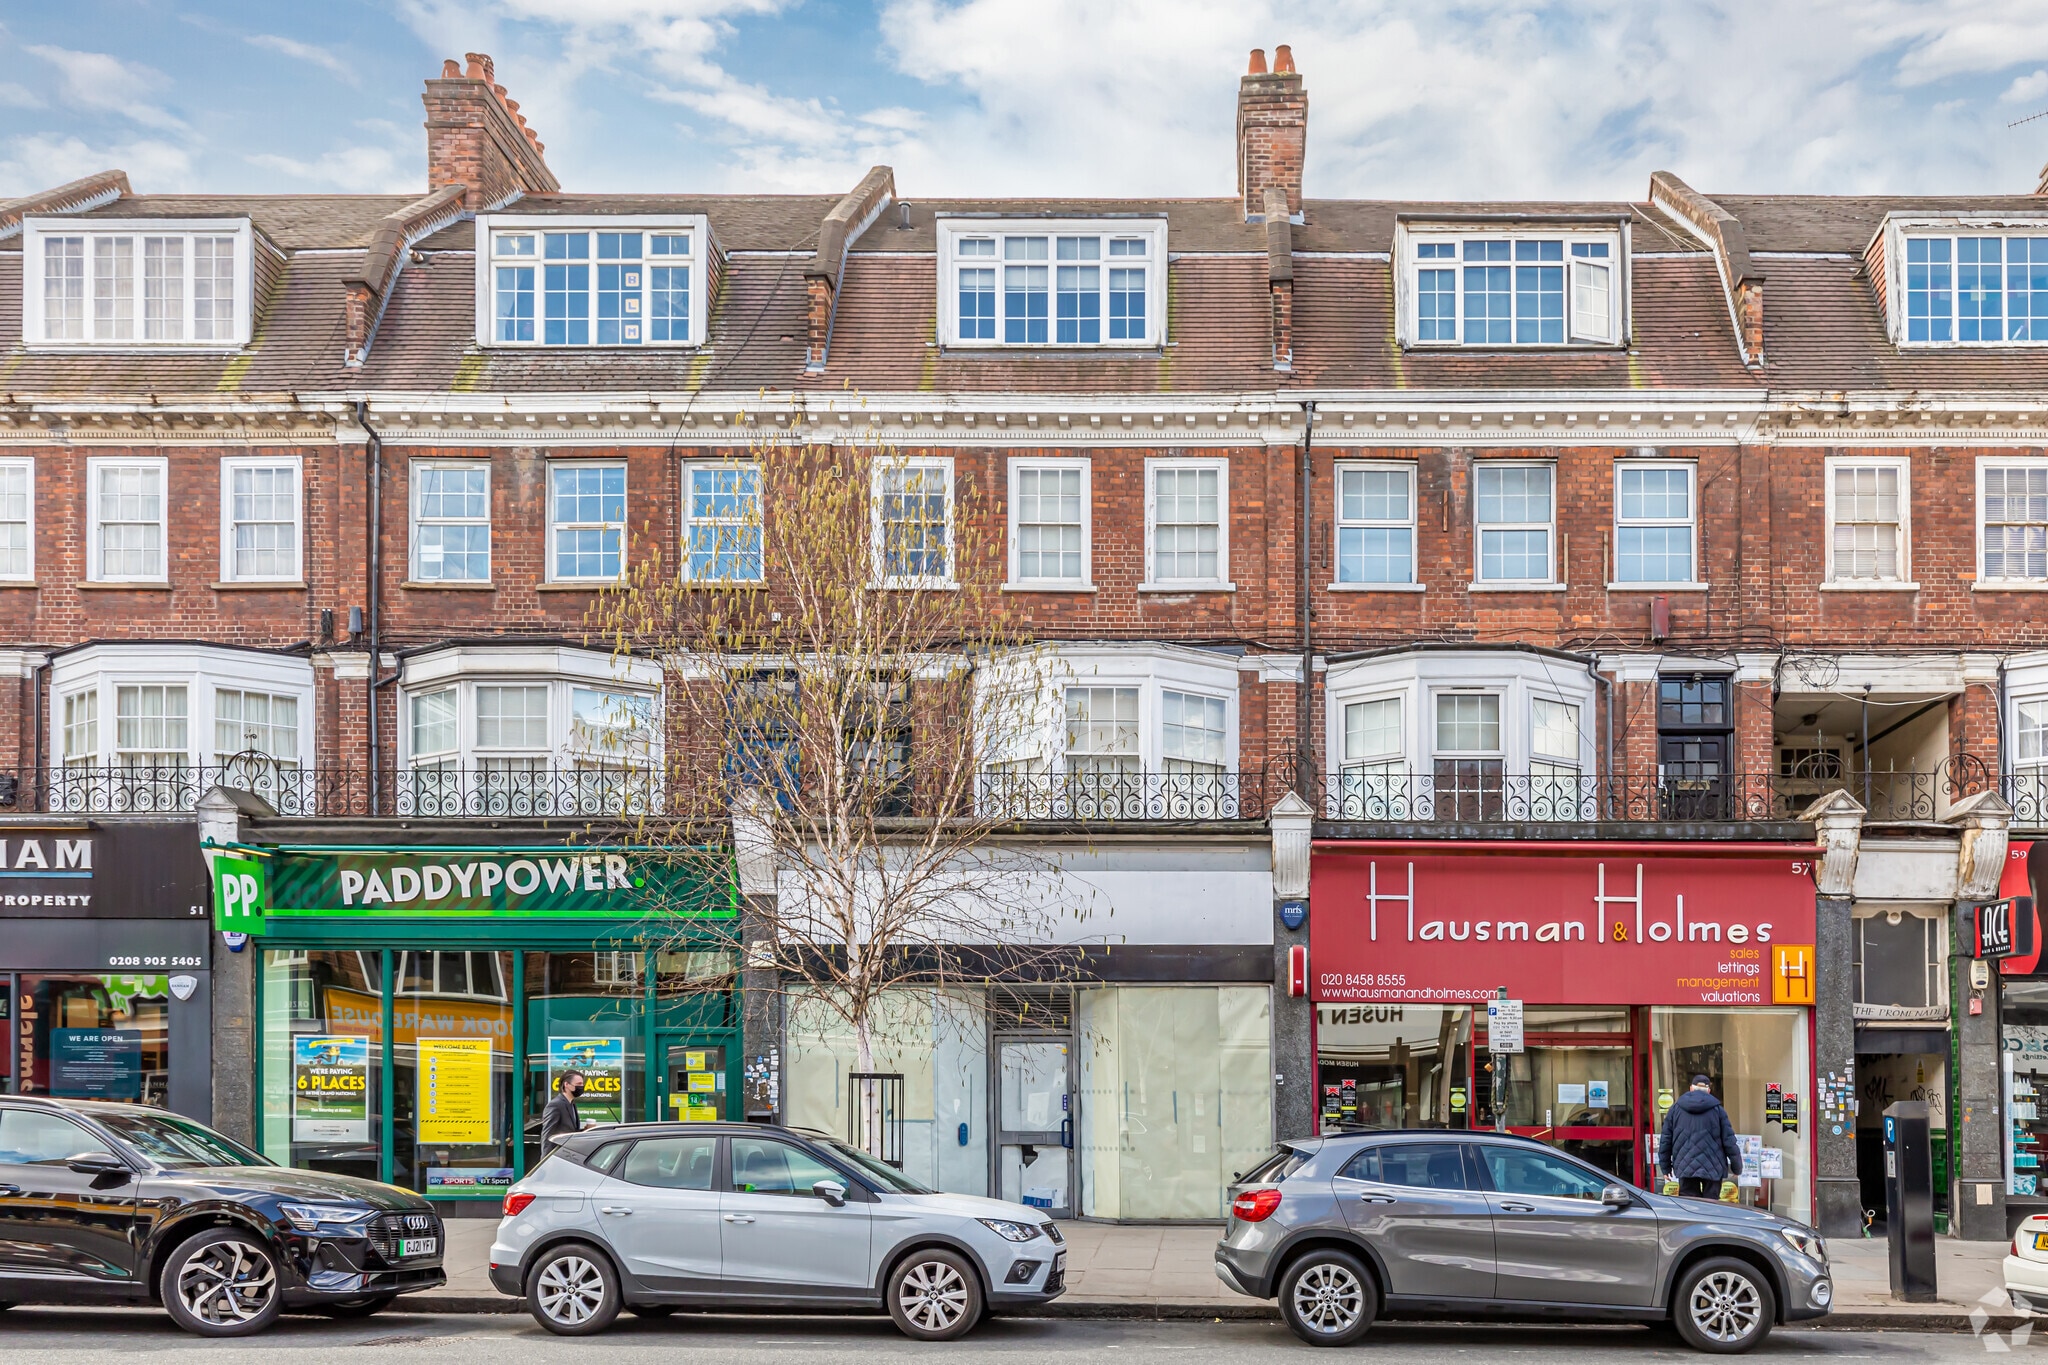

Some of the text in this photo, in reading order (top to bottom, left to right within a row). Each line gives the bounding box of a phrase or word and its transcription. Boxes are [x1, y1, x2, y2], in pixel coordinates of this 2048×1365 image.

[0, 839, 93, 869] AM
[2011, 850, 2027, 860] 59
[1791, 862, 1811, 876] 57
[0, 895, 91, 906] ROPERTY
[1366, 861, 1773, 944] Hausman & Holmes
[190, 906, 204, 915] 51
[1982, 904, 2009, 947] ACE
[1730, 948, 1760, 959] sales
[109, 956, 202, 966] 0208 905 5405
[1718, 961, 1760, 976] lettings
[1320, 973, 1406, 987] 020 8458 8555
[1677, 976, 1760, 990] management
[1701, 990, 1760, 1003] valuations
[309, 1067, 353, 1075] WE'RE PAYING
[297, 1075, 366, 1090] 6 PLACES
[1888, 1119, 1894, 1138] P
[431, 1177, 442, 1185] sky
[406, 1238, 434, 1253] GJ21 YFV
